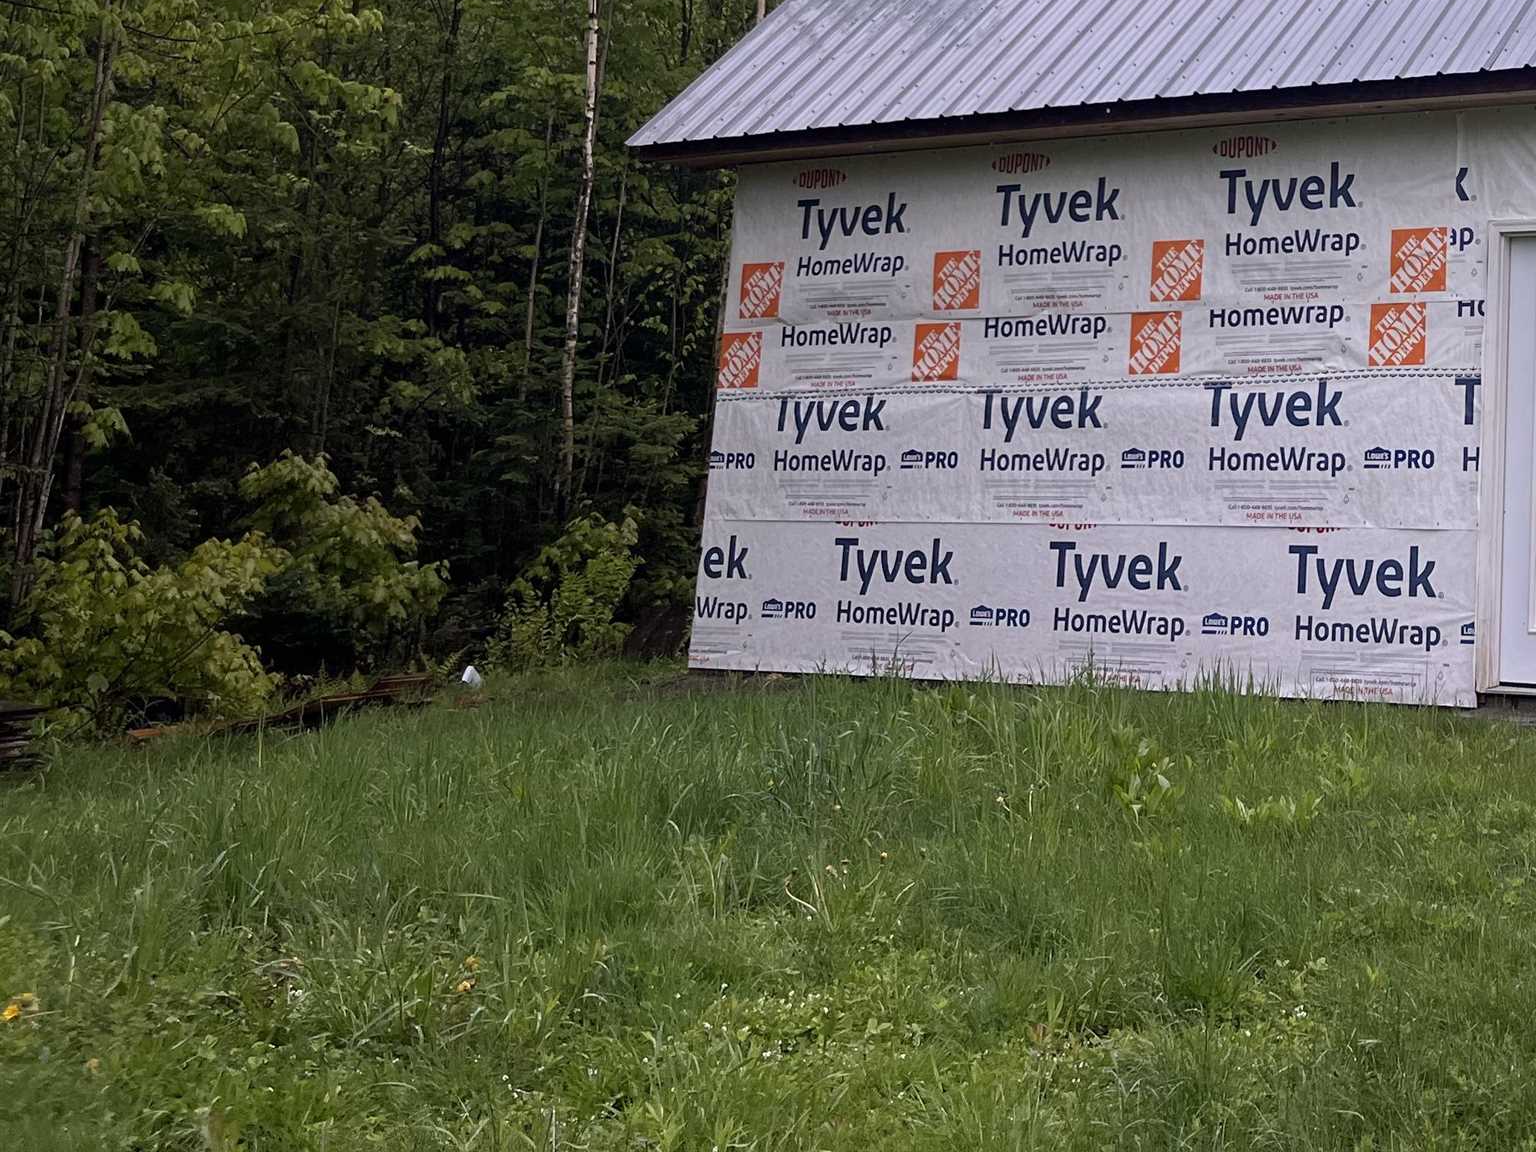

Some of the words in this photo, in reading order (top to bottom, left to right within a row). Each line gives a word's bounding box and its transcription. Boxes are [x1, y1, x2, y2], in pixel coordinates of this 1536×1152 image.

[1220, 136, 1270, 158] DUPONT
[1220, 161, 1355, 226] Tyvek
[996, 177, 1120, 238] Tyvek
[797, 192, 907, 250] Tyvek
[998, 240, 1121, 266] HomeWrap
[1225, 229, 1360, 256] HomeWrap
[796, 252, 905, 278] HomeWrap
[984, 314, 1106, 339] HomeWrap
[1209, 304, 1344, 329] HomeWrap
[781, 322, 892, 348] HomeWrap
[978, 386, 1103, 442] Tyvek
[1204, 379, 1342, 441] Tyvek
[726, 453, 755, 469] PRO
[774, 450, 886, 476] HomeWrap
[925, 451, 958, 469] PRO
[980, 448, 1105, 476] HomeWrap
[1148, 450, 1184, 469] PRO
[1209, 447, 1345, 477] HomeWrap
[1394, 449, 1435, 469] PRO
[835, 537, 954, 595] Tyvek
[1050, 541, 1182, 602] Tyvek
[1289, 545, 1436, 610] Tyvek
[785, 601, 816, 619] PRO
[837, 600, 955, 632] HomeWrap
[995, 608, 1030, 627] PRO
[1053, 607, 1185, 641] HomeWrap
[1231, 616, 1269, 636] PRO
[1296, 615, 1440, 651] HomeWrap
